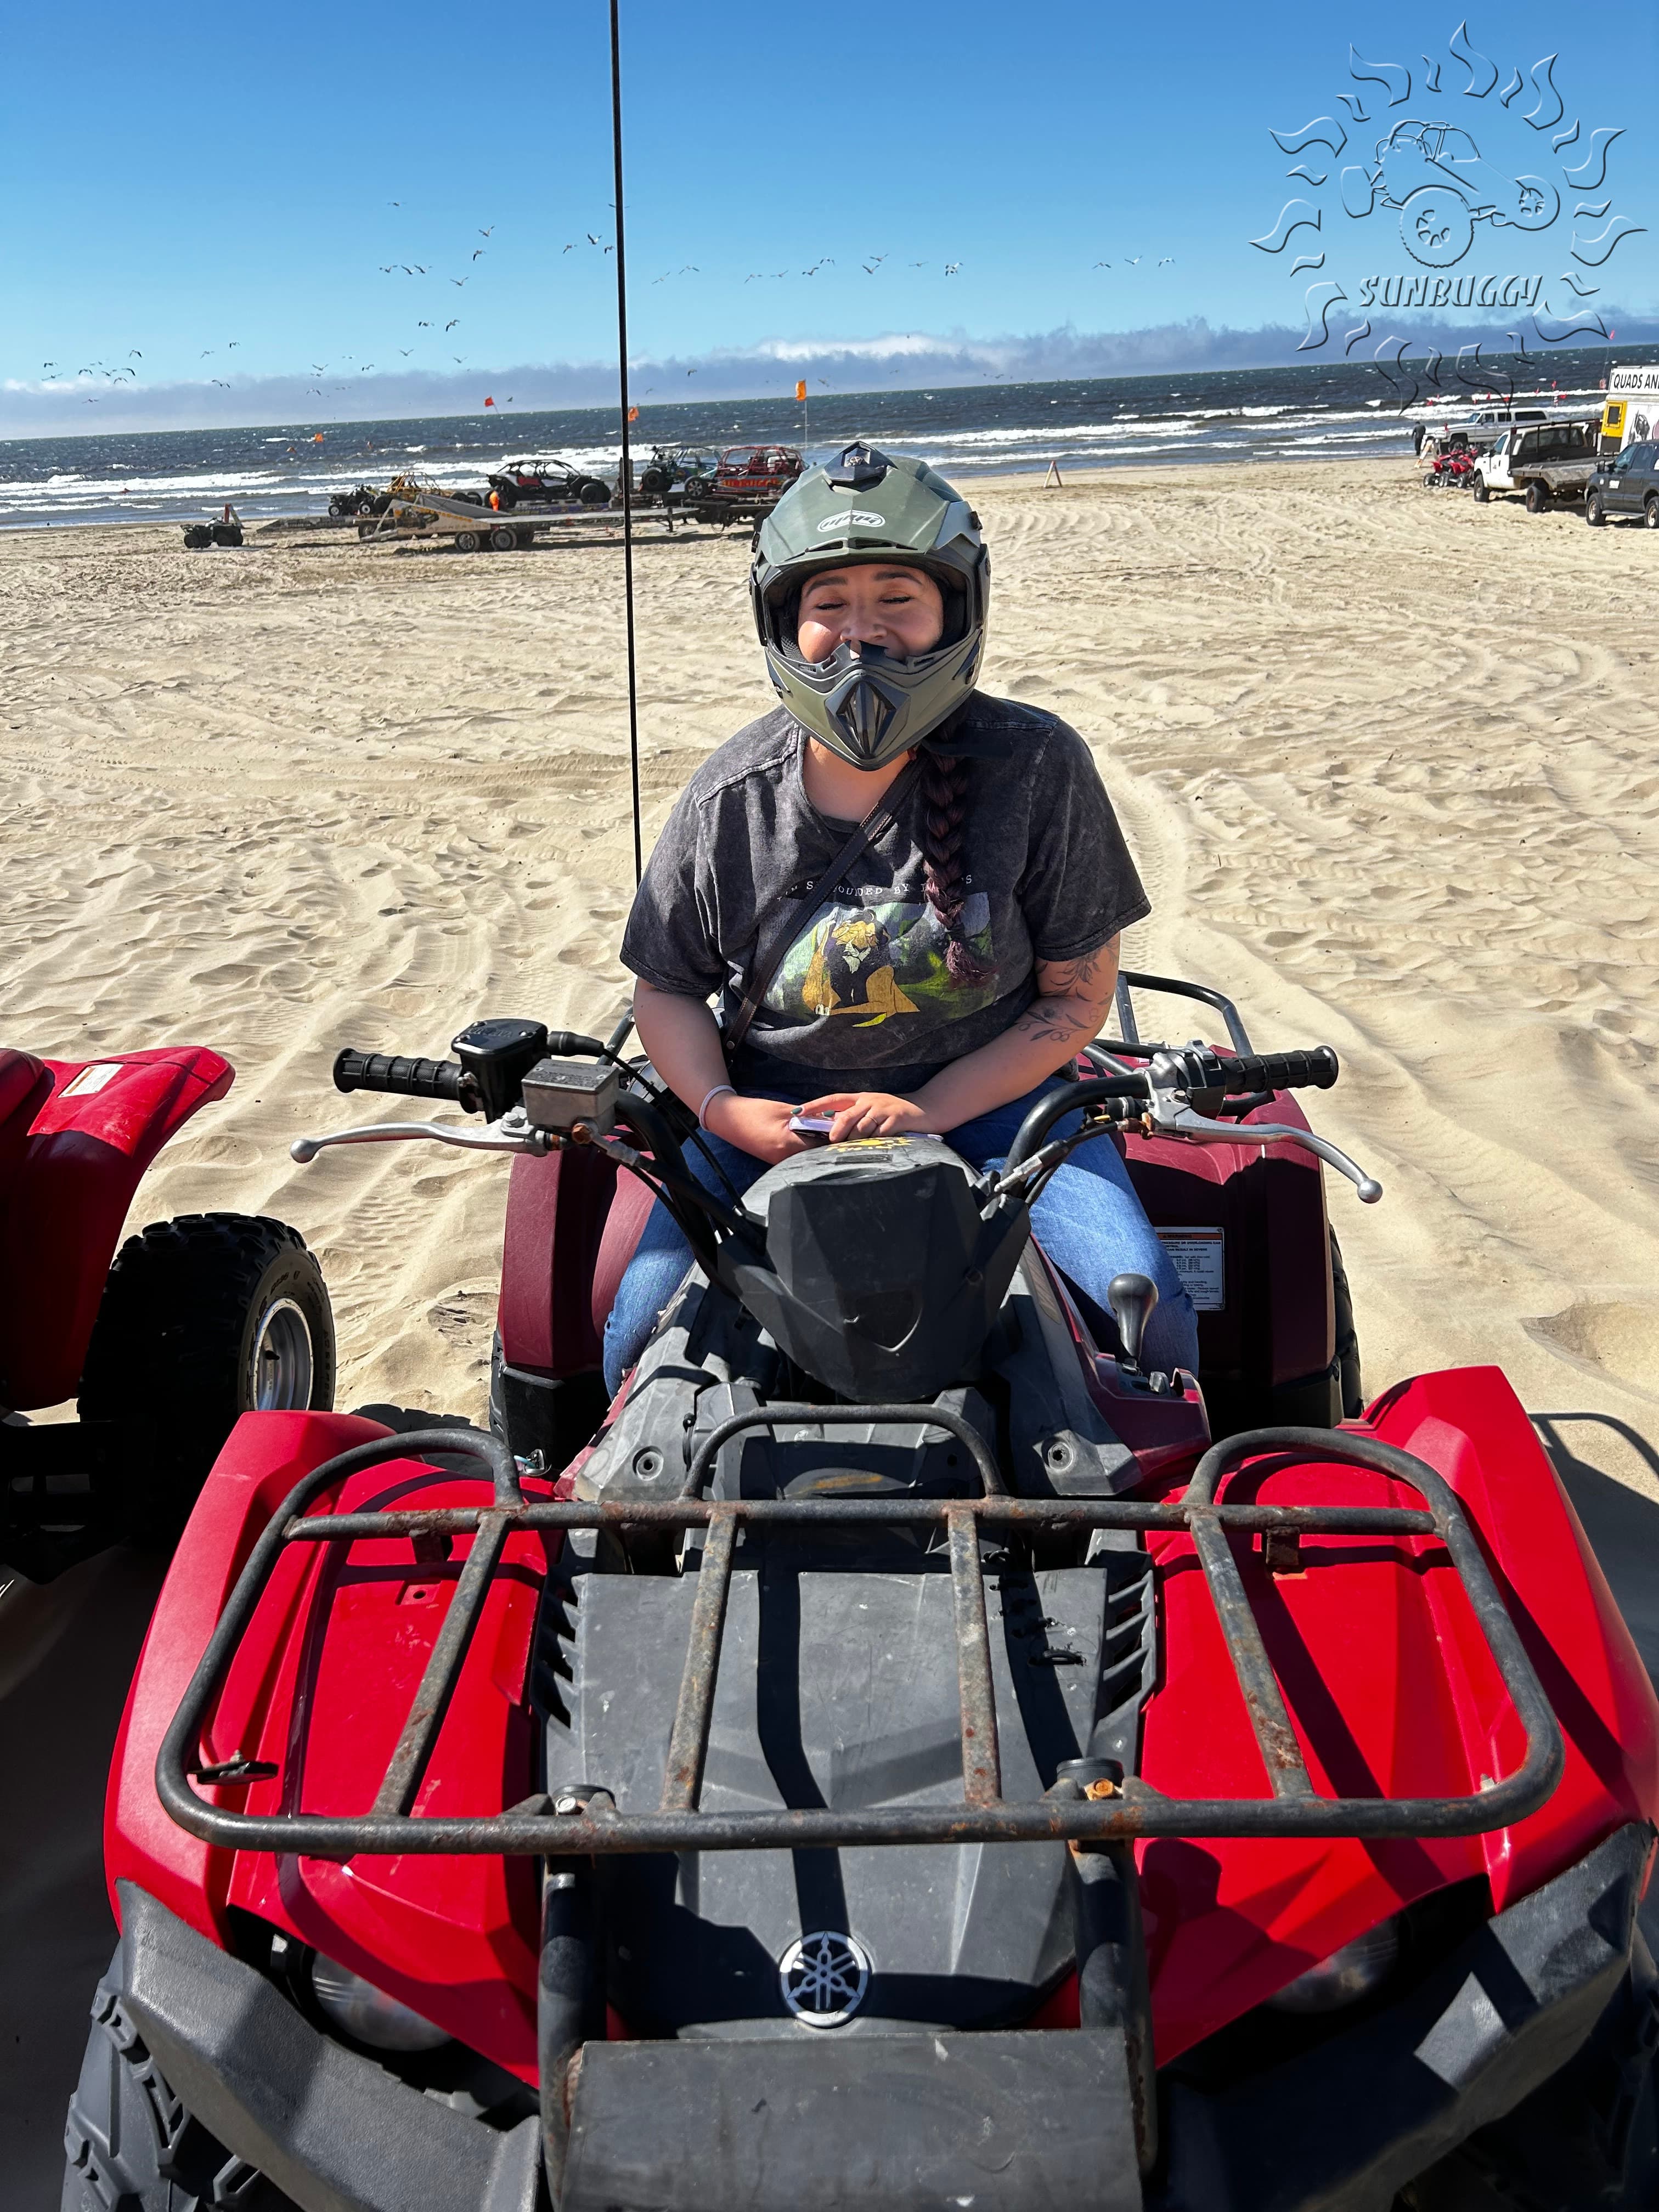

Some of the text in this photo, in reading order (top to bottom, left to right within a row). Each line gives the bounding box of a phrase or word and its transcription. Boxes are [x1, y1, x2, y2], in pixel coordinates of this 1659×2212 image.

[1614, 374, 1659, 390] QUADS AN
[806, 881, 883, 896] SOUNDED
[894, 883, 909, 894] BY
